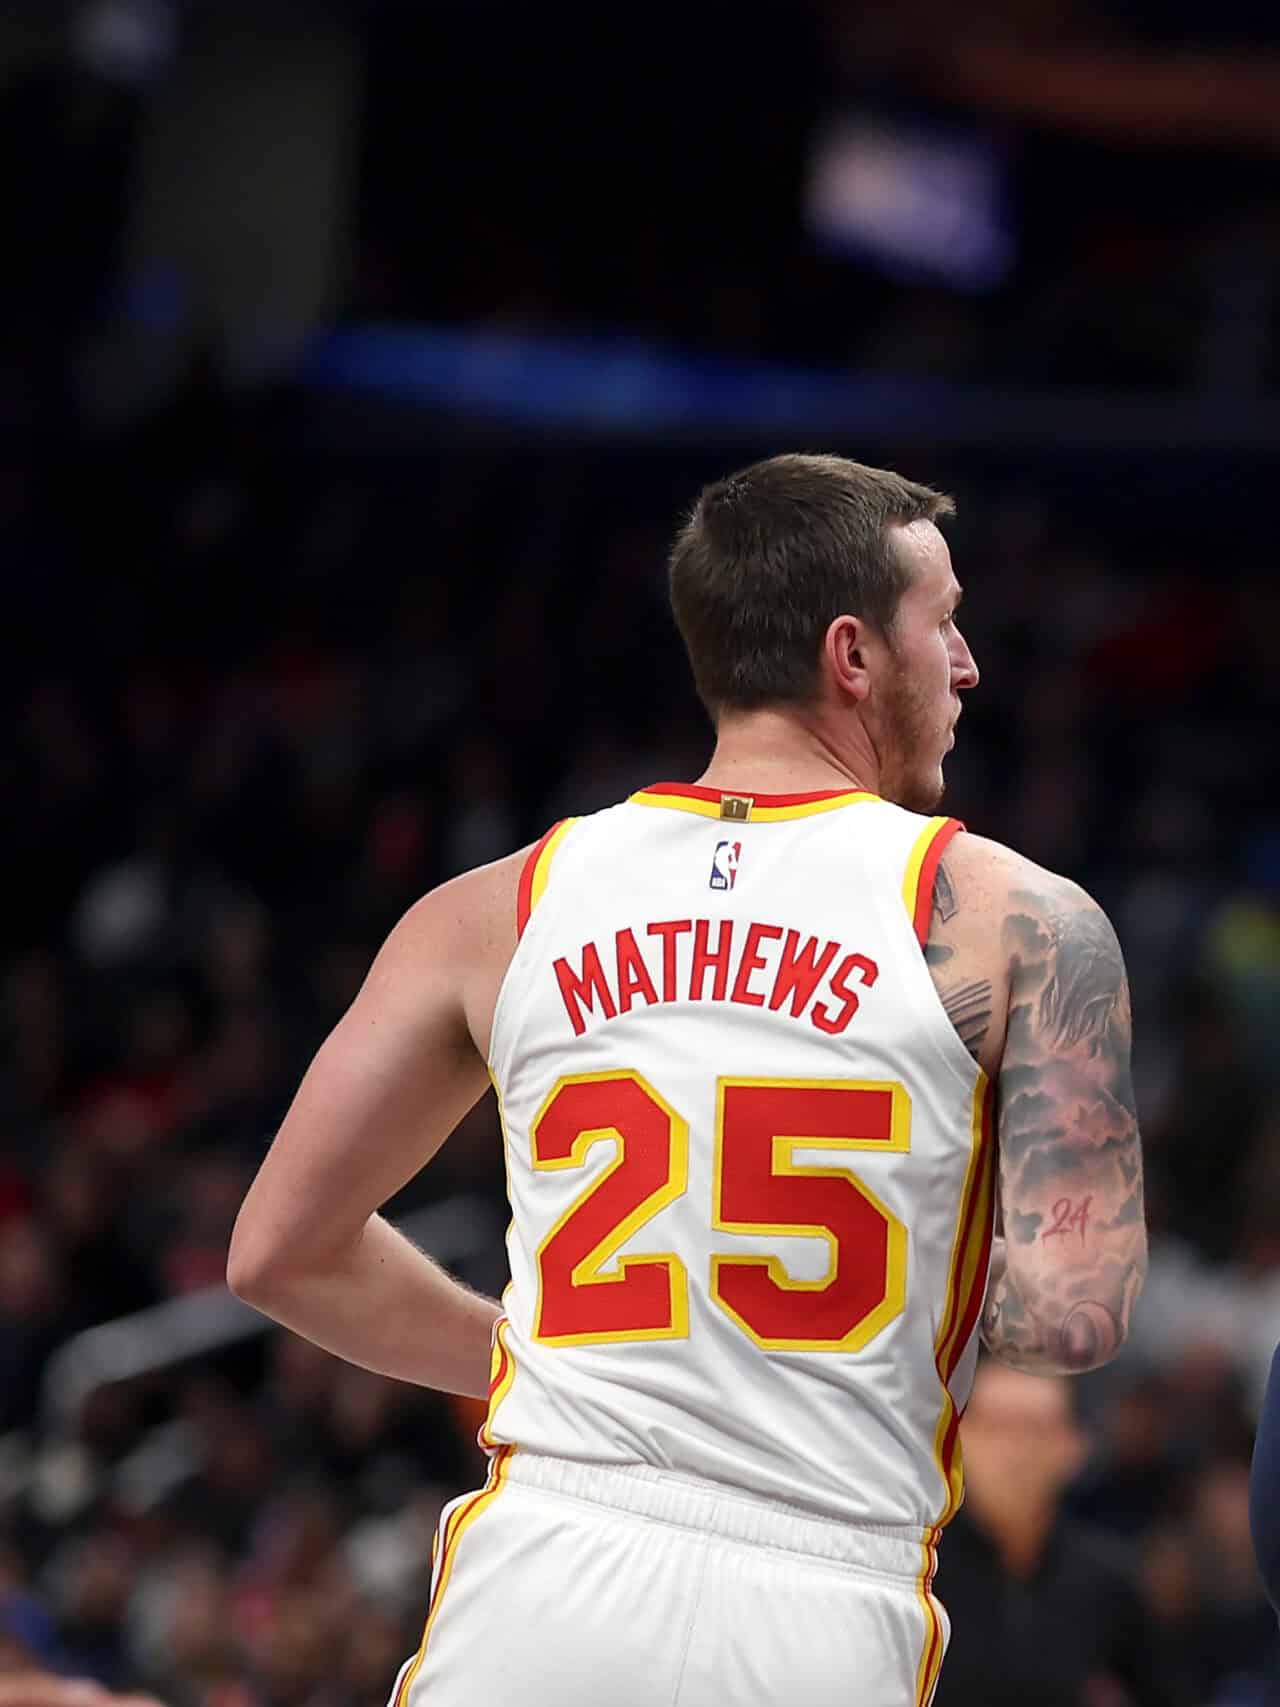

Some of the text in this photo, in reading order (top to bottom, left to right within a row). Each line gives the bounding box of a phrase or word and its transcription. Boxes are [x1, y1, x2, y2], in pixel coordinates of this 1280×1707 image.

[552, 919, 879, 1036] MATHEWS
[529, 1067, 912, 1352] 25
[1041, 1195, 1093, 1248] 24
